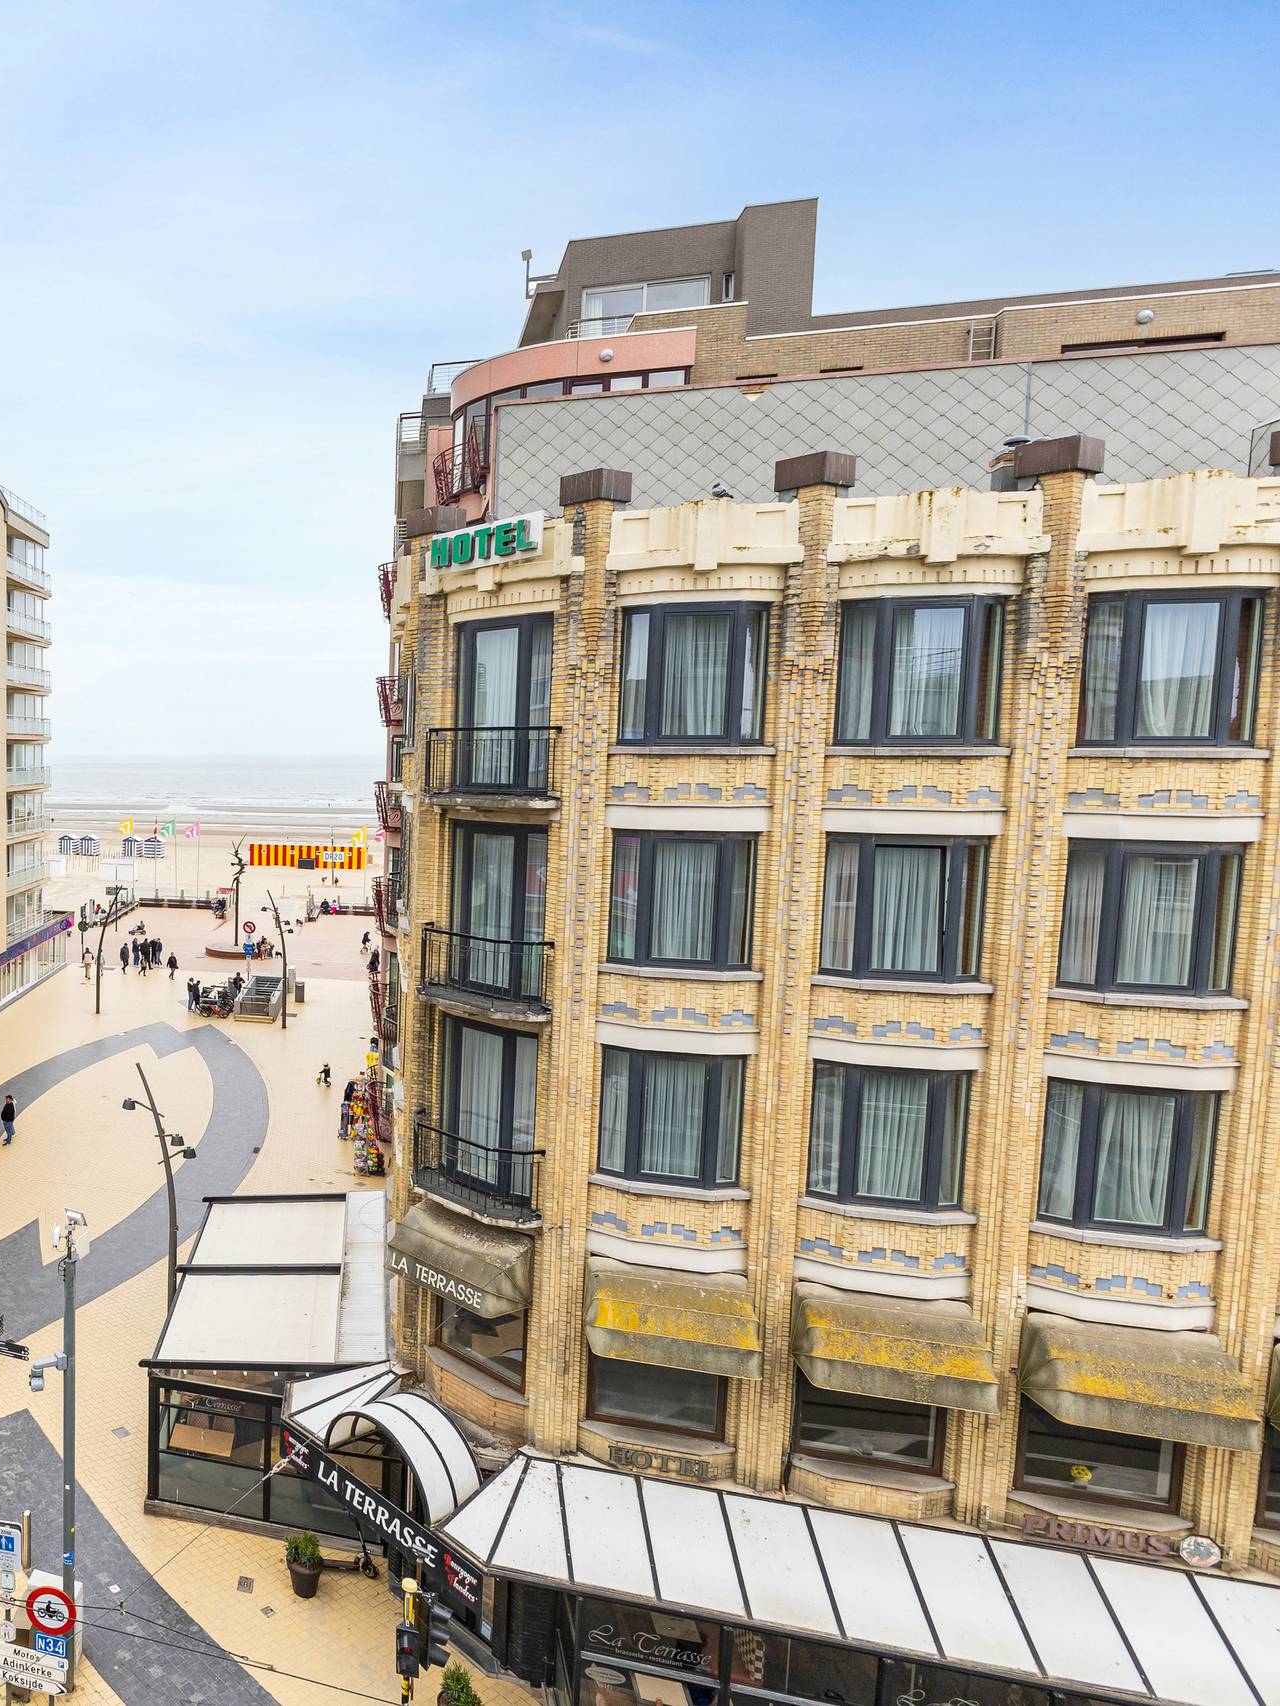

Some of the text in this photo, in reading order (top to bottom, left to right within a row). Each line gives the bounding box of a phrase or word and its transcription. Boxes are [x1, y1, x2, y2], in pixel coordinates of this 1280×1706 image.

[431, 519, 536, 569] HOTEL
[391, 1252, 482, 1309] LA TERRASSE
[608, 1445, 721, 1482] HOTEL
[317, 1460, 439, 1569] LA TERRASSE
[1023, 1514, 1170, 1556] PRIMUS
[13, 1648, 40, 1662] Moto's
[38, 1638, 64, 1655] N34
[587, 1624, 712, 1665] La Terrasse
[615, 1648, 683, 1667] brasserie restaurant
[2, 1657, 52, 1678] Adinkerke
[2, 1670, 44, 1690] Koksijde
